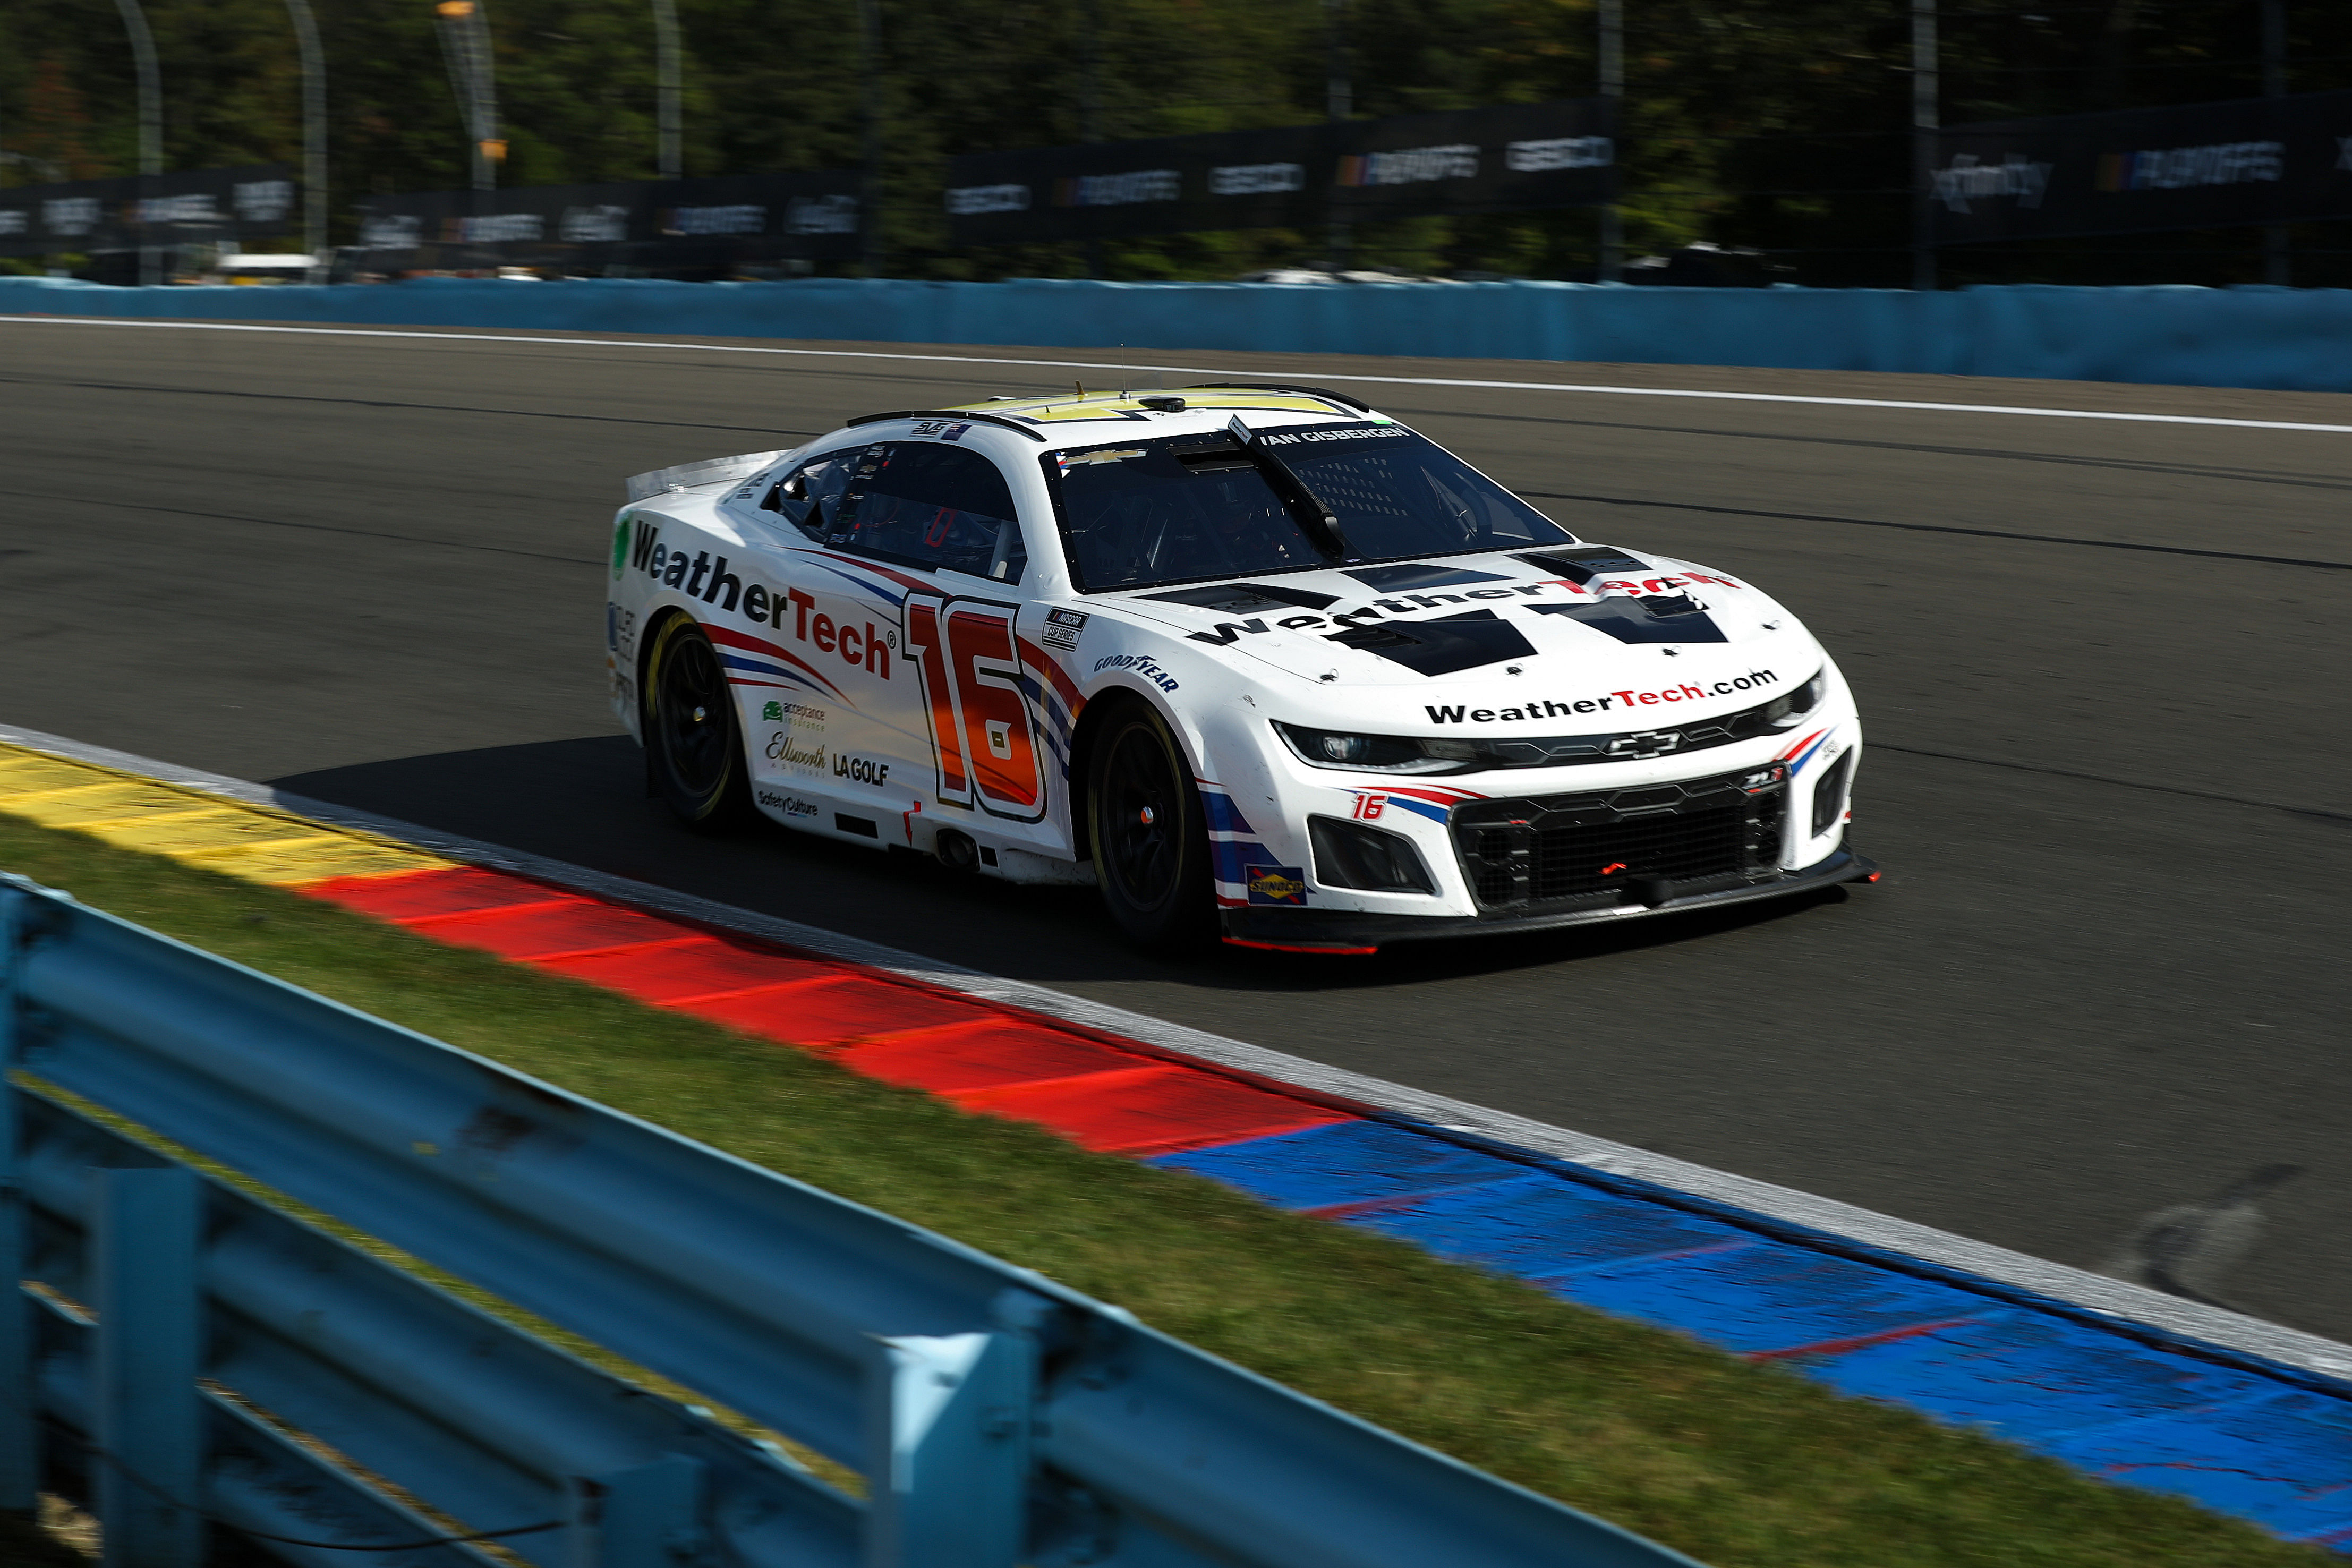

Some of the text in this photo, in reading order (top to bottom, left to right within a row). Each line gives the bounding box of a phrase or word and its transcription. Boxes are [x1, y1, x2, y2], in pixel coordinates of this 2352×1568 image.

[1301, 427, 1410, 441] GISBERGEN
[632, 519, 890, 681] WeatherTech
[1184, 572, 1741, 646] WeatherTech
[1047, 626, 1075, 641] CUP SERIES
[1058, 612, 1081, 626] NASCAR
[1094, 654, 1179, 693] GOODYEAR
[783, 702, 825, 721] acceptance
[905, 594, 1044, 818] 16
[1425, 668, 1780, 724] WeatherTech.com
[765, 731, 826, 769] Ellsworth
[833, 753, 890, 787] LA GOLF
[1351, 792, 1389, 822] 16
[1251, 880, 1302, 892] SUNOCO
